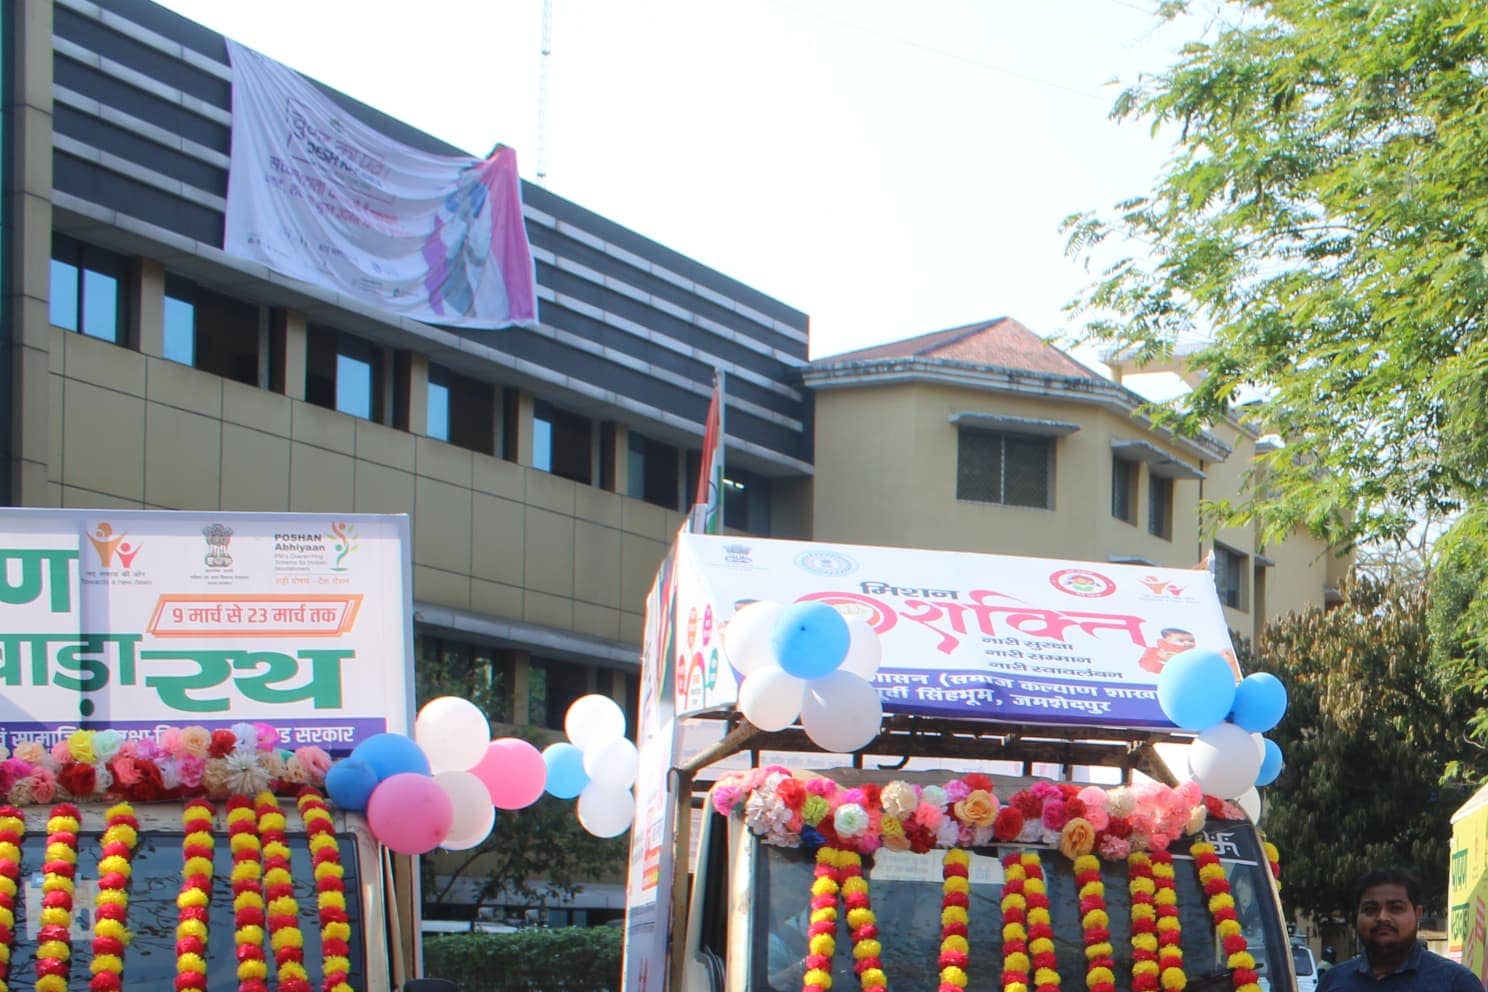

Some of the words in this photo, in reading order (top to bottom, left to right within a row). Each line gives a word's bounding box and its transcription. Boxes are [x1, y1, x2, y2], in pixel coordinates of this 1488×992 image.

[274, 534, 322, 542] POSHAN
[275, 543, 326, 552] Abhiyaan
[860, 581, 960, 600] मिशन
[172, 608, 184, 624] 9
[188, 604, 223, 623] मार्च
[226, 604, 243, 624] से
[248, 608, 268, 623] 23
[272, 604, 306, 623] मार्च
[309, 607, 338, 623] तक
[899, 589, 1148, 655] शक्ति
[981, 637, 1020, 646] नारी
[984, 649, 1024, 658] नारी
[1028, 653, 1092, 664] सम्मान
[988, 661, 1028, 671] नारी
[140, 649, 356, 713] रथ
[1018, 680, 1098, 697] कल्याण
[1009, 694, 1112, 715] जमशेदपुर
[295, 725, 355, 743] सरकार
